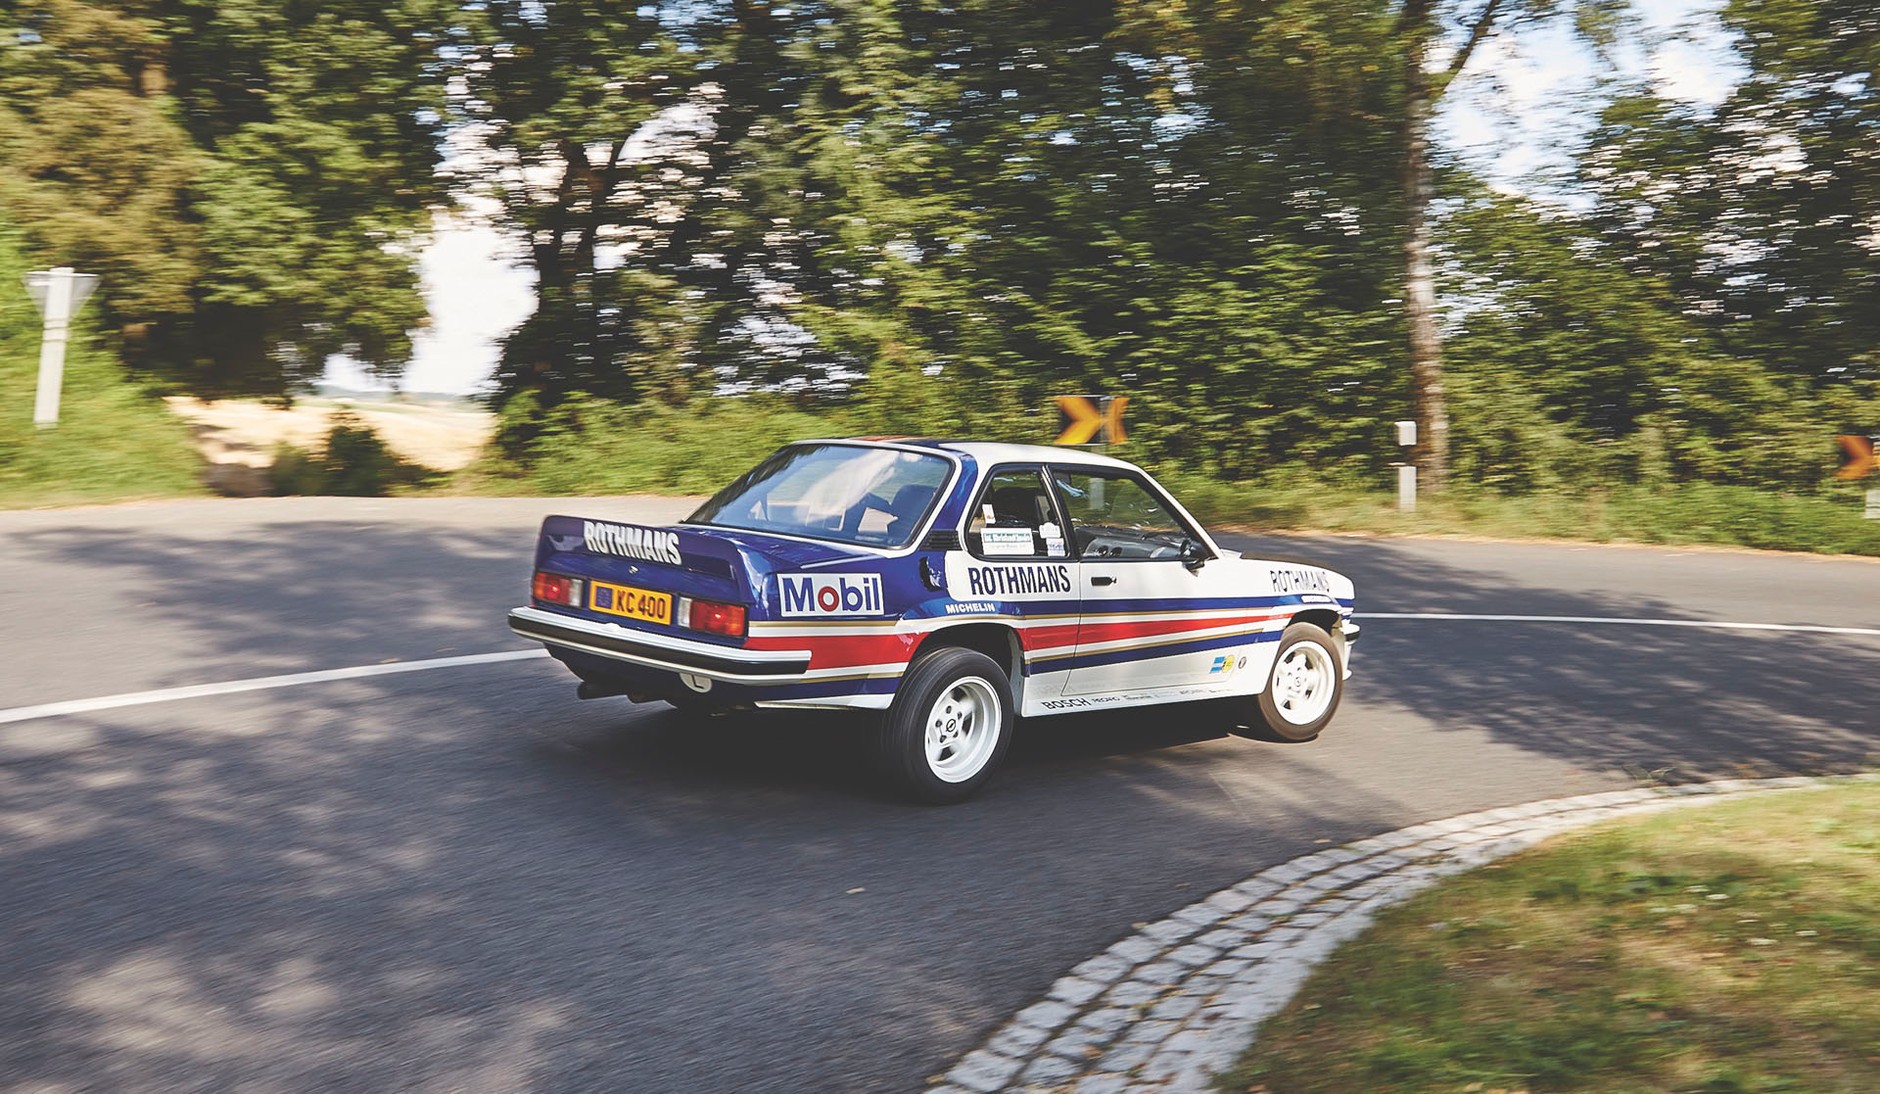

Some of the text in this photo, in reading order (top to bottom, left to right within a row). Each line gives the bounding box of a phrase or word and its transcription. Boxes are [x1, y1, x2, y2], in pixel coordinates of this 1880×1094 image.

[584, 520, 682, 565] ROTHMANS
[968, 564, 1071, 596] ROTHMANS
[1270, 570, 1330, 592] ROTHMANS
[616, 590, 666, 619] KC 400
[782, 576, 881, 613] Mobil
[945, 601, 996, 615] MICHELIN
[691, 674, 705, 690] L
[1041, 698, 1091, 709] BOSCH
